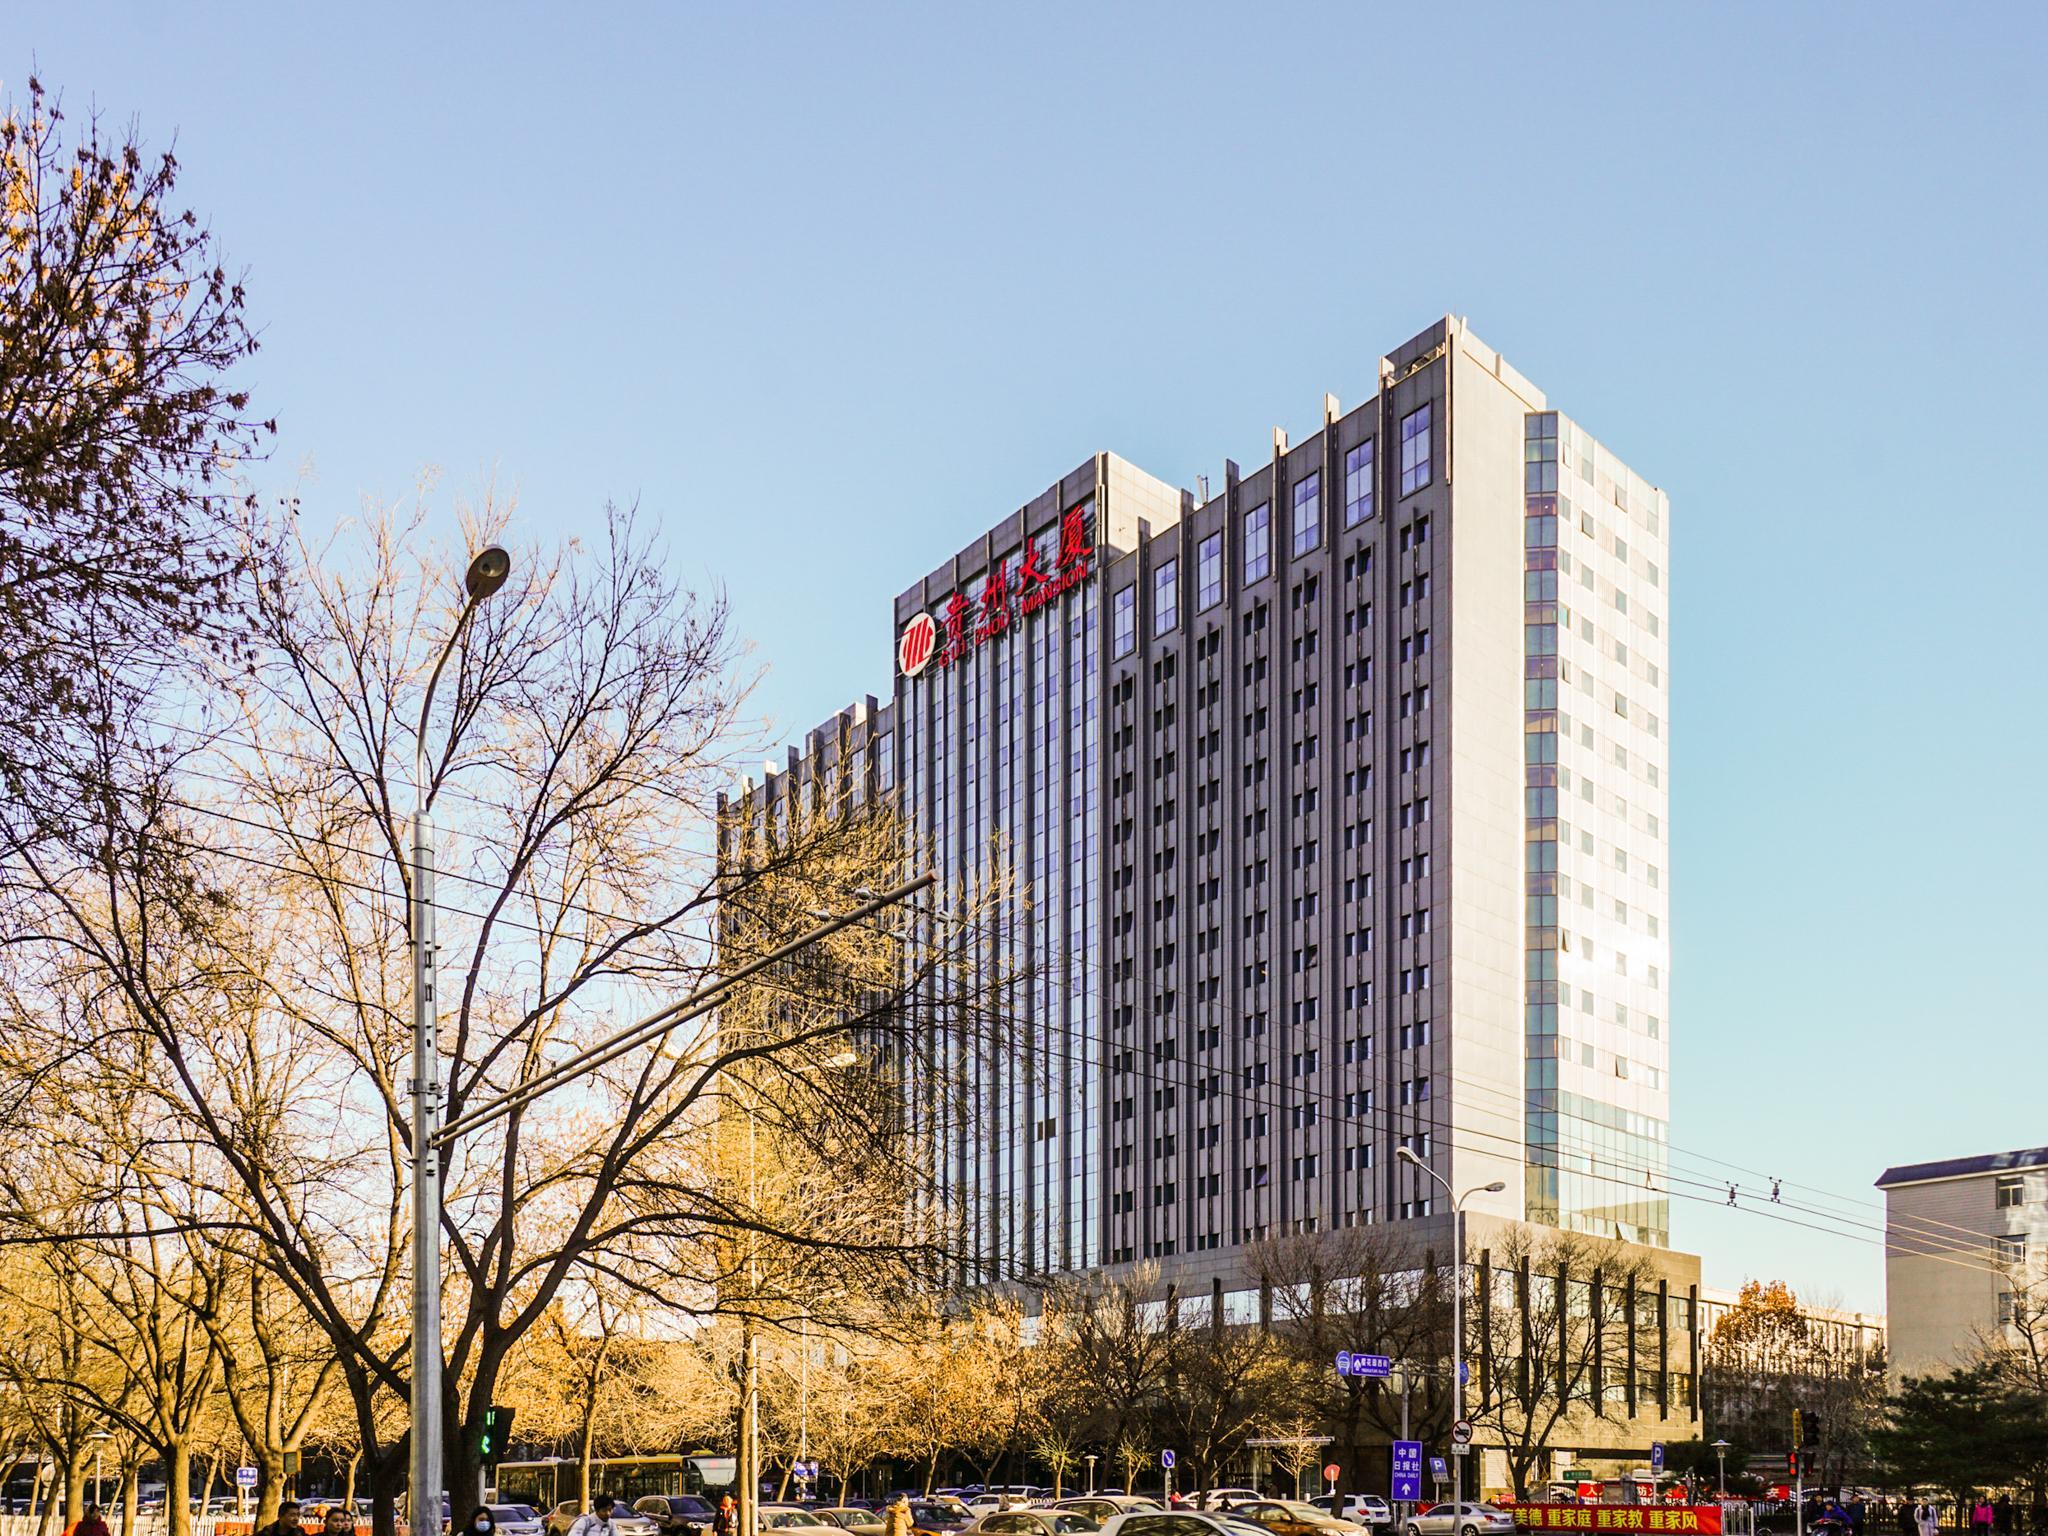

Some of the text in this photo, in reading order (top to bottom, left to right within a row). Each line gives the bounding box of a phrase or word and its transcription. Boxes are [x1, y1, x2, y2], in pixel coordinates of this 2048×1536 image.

[940, 504, 1094, 648] 贵州大厦
[1021, 560, 1088, 617] MANSION
[1398, 1447, 1417, 1459] 中国
[1654, 1446, 1662, 1463] P
[1394, 1460, 1419, 1471] 日报社
[1434, 1460, 1442, 1470] P
[1547, 1508, 1592, 1528] 重家庭
[1596, 1509, 1643, 1529] 重家教
[1648, 1509, 1698, 1530] 重家风
